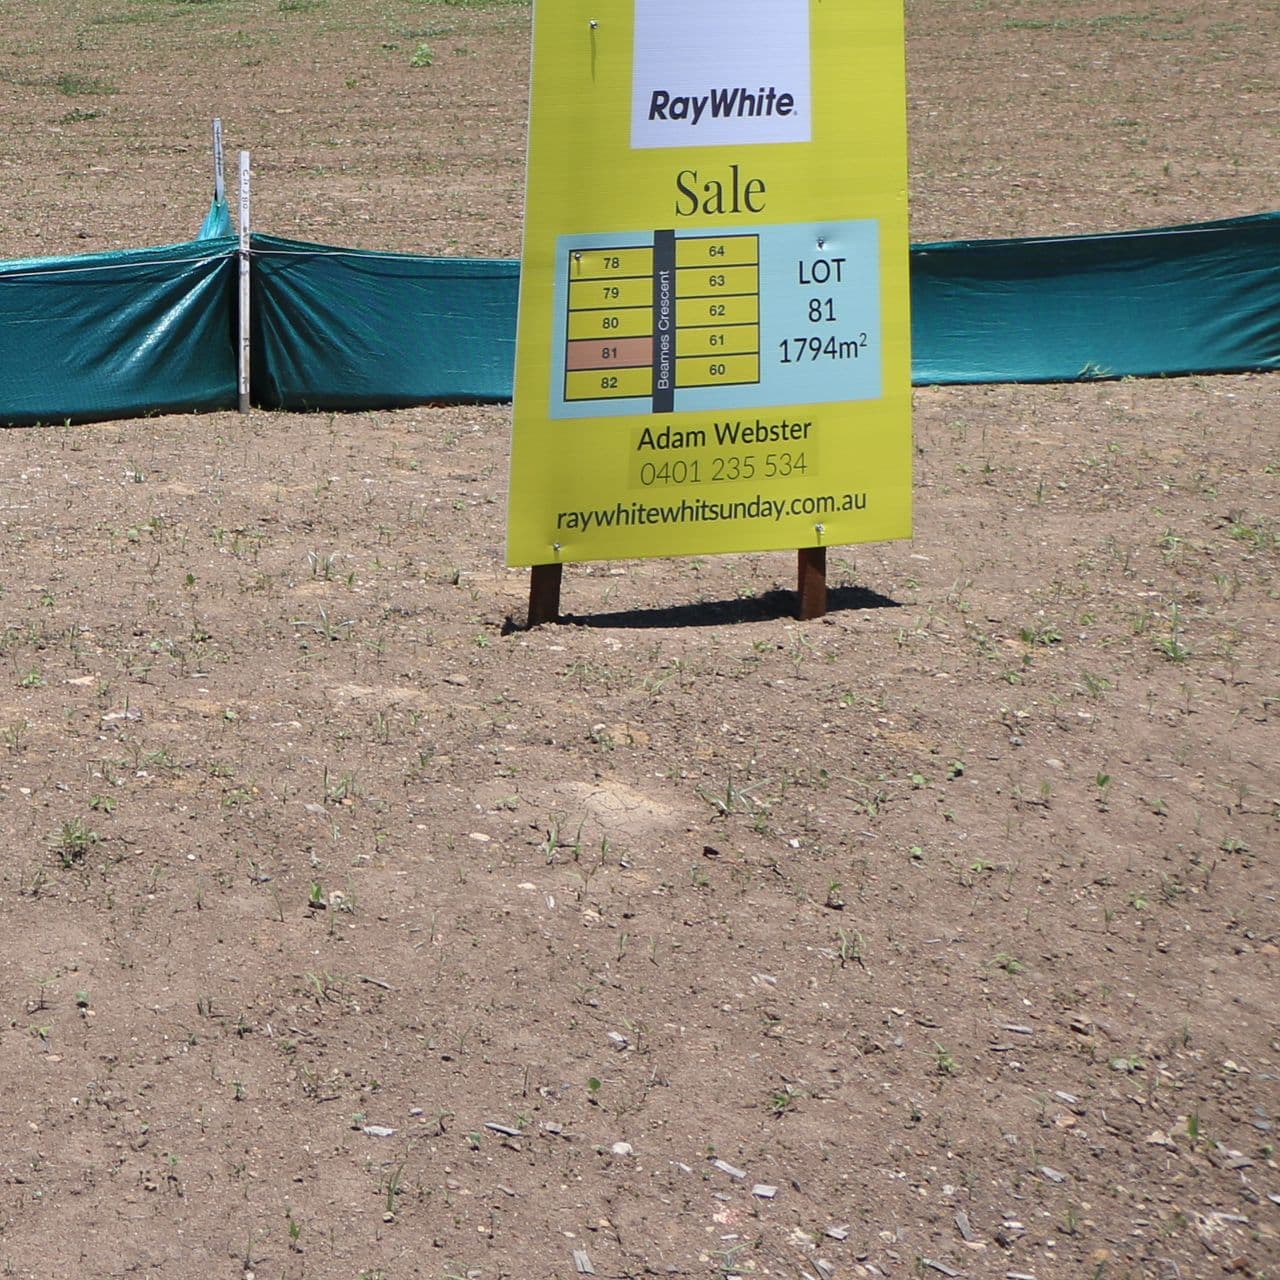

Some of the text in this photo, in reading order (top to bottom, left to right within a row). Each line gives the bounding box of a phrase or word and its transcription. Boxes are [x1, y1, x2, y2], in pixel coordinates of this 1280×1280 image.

[648, 86, 794, 125] RayWhite
[675, 164, 766, 217] Sale
[708, 245, 725, 257] 64
[603, 257, 620, 269] 78
[798, 258, 846, 284] LOT
[708, 275, 725, 287] 63
[603, 287, 619, 299] 79
[709, 305, 726, 317] 62
[808, 297, 837, 322] 81
[602, 317, 619, 329] 80
[657, 270, 670, 389] Beames Crescent
[709, 334, 725, 346] 61
[601, 347, 618, 359] 81
[709, 364, 726, 376] 60
[601, 377, 618, 389] 82
[637, 419, 812, 451] Adam Webster
[640, 452, 808, 486] 0401 235 534
[556, 492, 867, 532] raywhitewhitsunday.com.au
